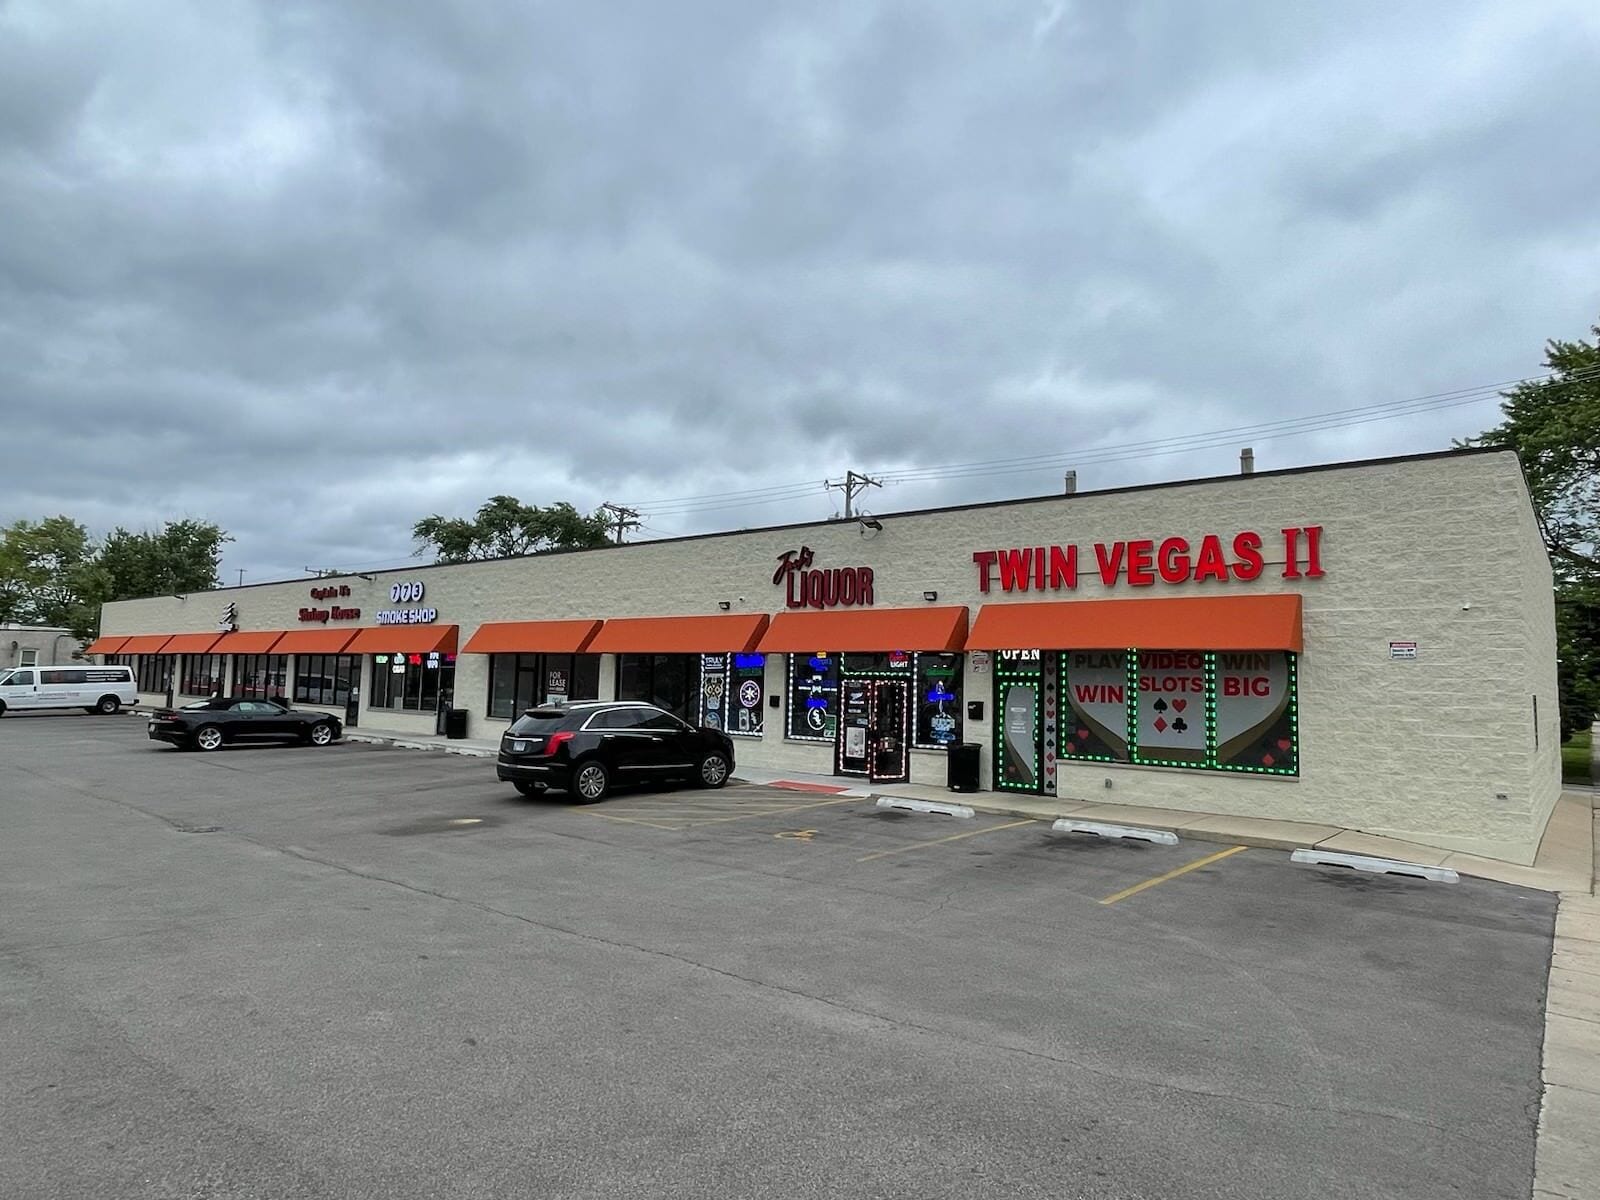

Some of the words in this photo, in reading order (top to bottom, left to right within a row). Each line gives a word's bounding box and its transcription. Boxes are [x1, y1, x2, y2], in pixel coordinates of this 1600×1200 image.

[973, 545, 1078, 593] TWIN
[1094, 531, 1264, 587] VEGAS
[1281, 526, 1326, 579] II
[390, 581, 425, 603] 773
[786, 567, 874, 609] LIQUOR
[331, 605, 361, 620] House
[1001, 648, 1040, 660] OPEN
[1075, 653, 1124, 669] PLAY
[1138, 652, 1205, 670] VIDEO
[1222, 652, 1271, 671] WIN
[550, 671, 561, 680] FOR
[550, 679, 566, 688] LEASE
[1138, 676, 1205, 693] SLOTS
[1075, 685, 1124, 705] WIN
[1223, 677, 1271, 697] BIG
